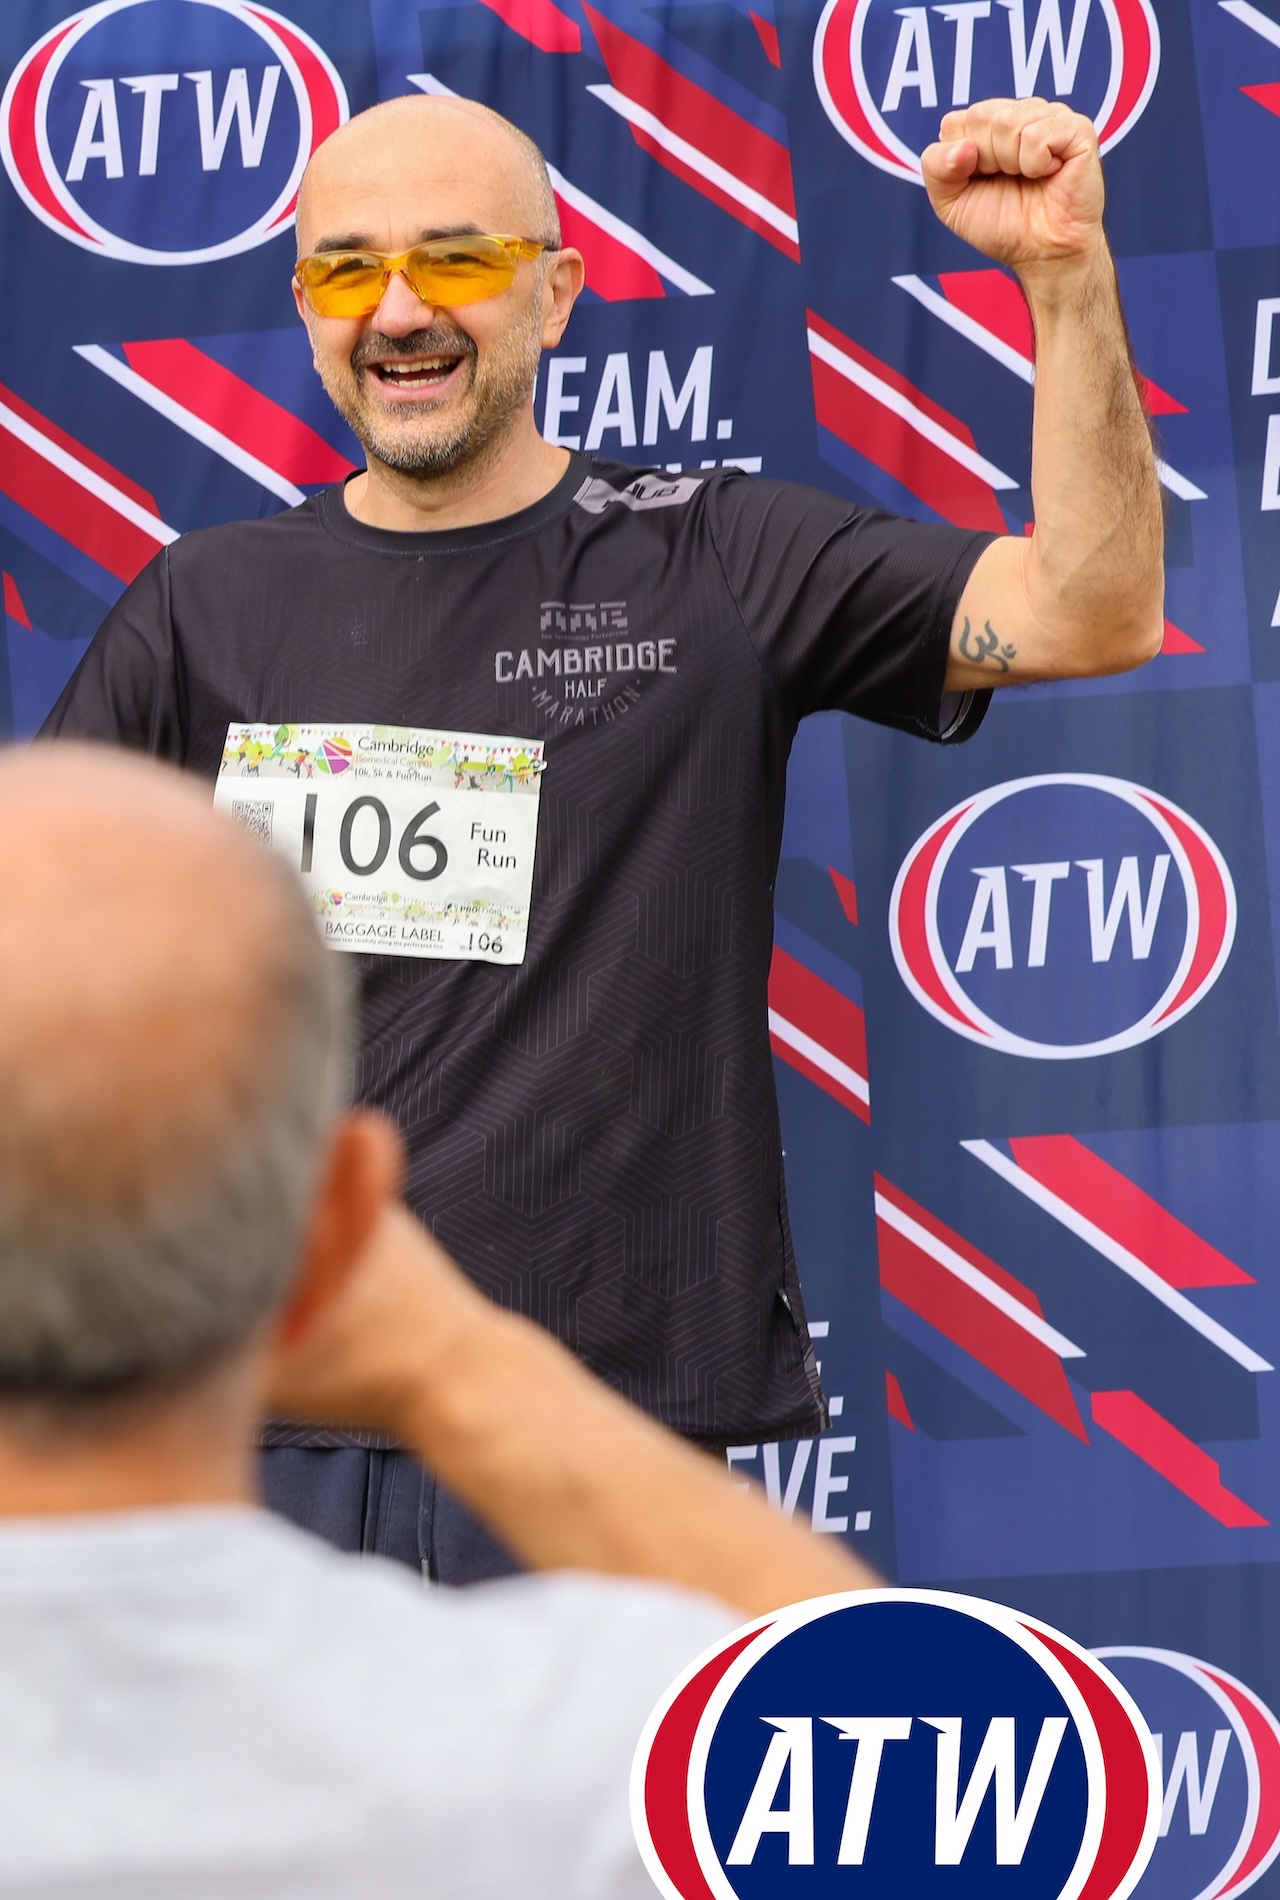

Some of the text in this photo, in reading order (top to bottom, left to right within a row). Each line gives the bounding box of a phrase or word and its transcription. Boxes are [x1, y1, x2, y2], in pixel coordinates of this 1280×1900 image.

[881, 0, 1091, 112] ATW
[65, 65, 282, 182] ATW
[532, 345, 733, 451] EAM.
[495, 637, 678, 683] CAMBRIDGE
[565, 678, 608, 699] HALF
[531, 683, 641, 726] MARATHON
[358, 736, 434, 759] Cambridge
[355, 753, 398, 766] Biomedical
[354, 767, 371, 779] 10k,
[372, 768, 383, 778] 5k
[385, 769, 393, 779] &
[300, 792, 448, 881] 106
[470, 821, 507, 844] Fun
[477, 848, 517, 870] Run
[344, 891, 388, 904] Cambridge
[955, 854, 1171, 973] ATW
[325, 921, 445, 943] BAGGAGE LABEL
[468, 932, 503, 954] 106
